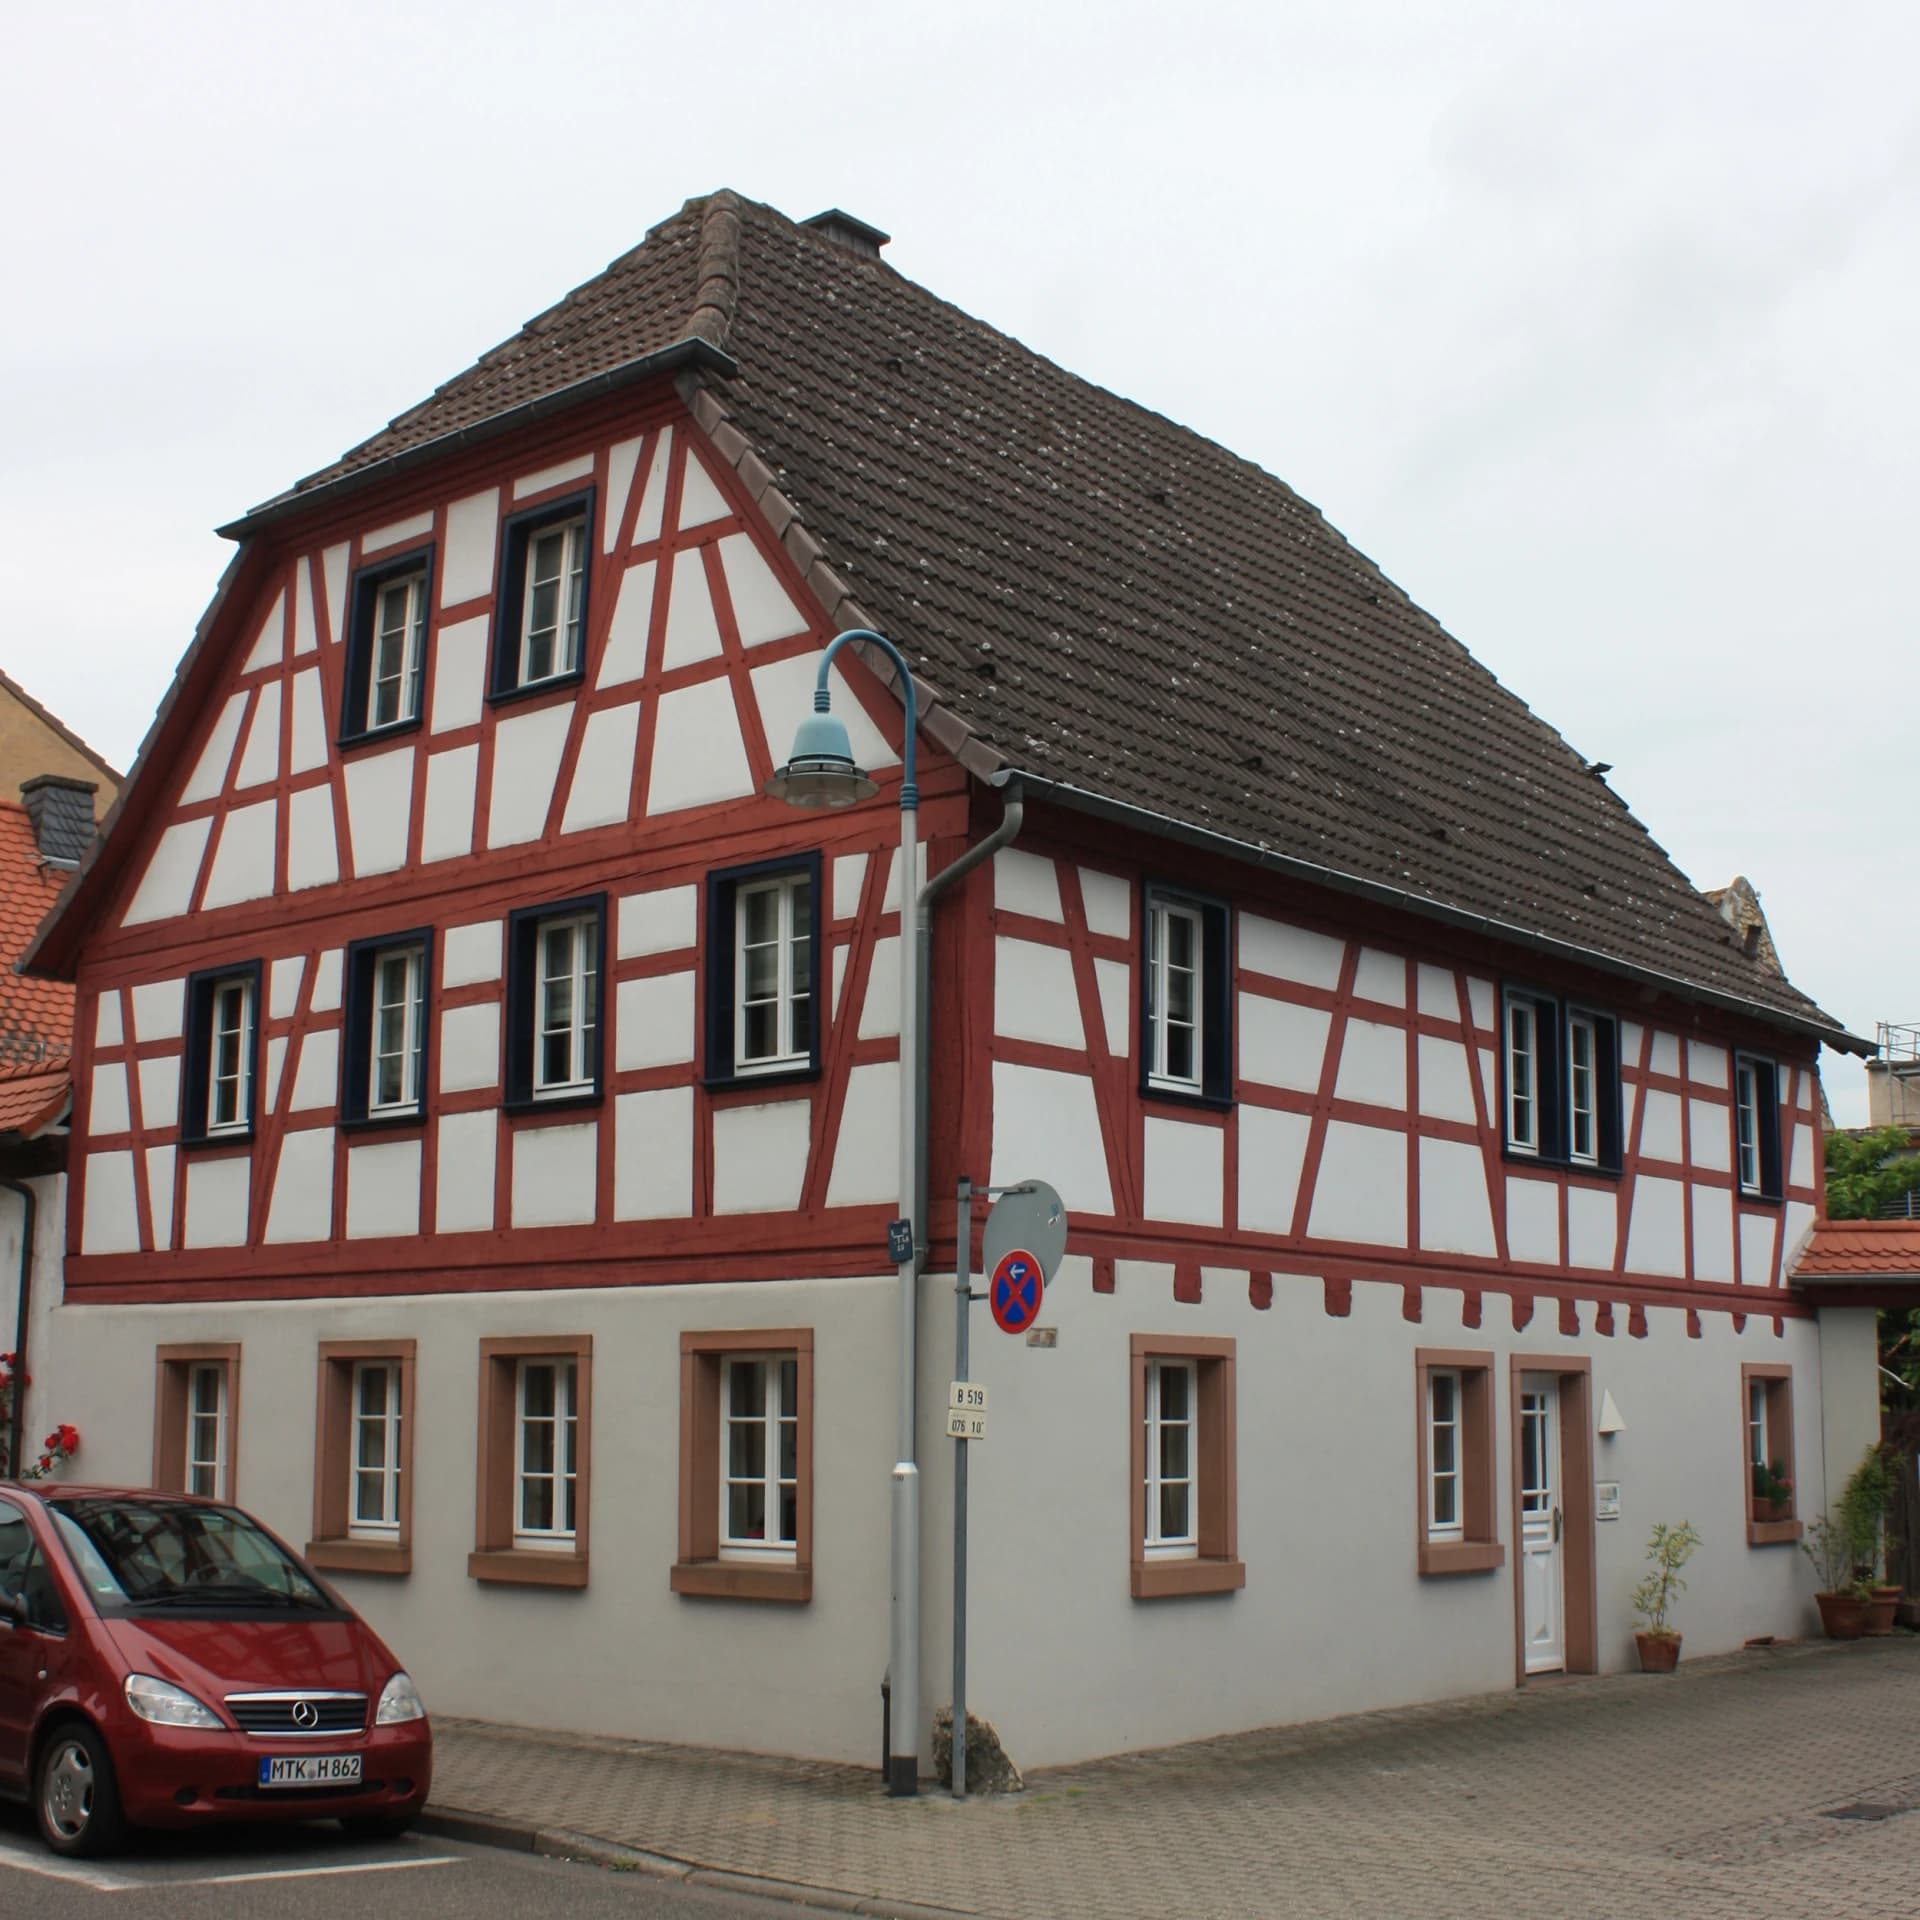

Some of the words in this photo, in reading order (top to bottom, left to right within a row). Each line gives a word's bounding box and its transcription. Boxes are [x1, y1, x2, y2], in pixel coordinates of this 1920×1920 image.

[958, 1388, 964, 1403] B
[968, 1389, 984, 1405] 519
[952, 1419, 966, 1433] 076
[271, 1760, 307, 1779] MTK
[318, 1760, 328, 1778] H
[332, 1758, 360, 1777] 862
